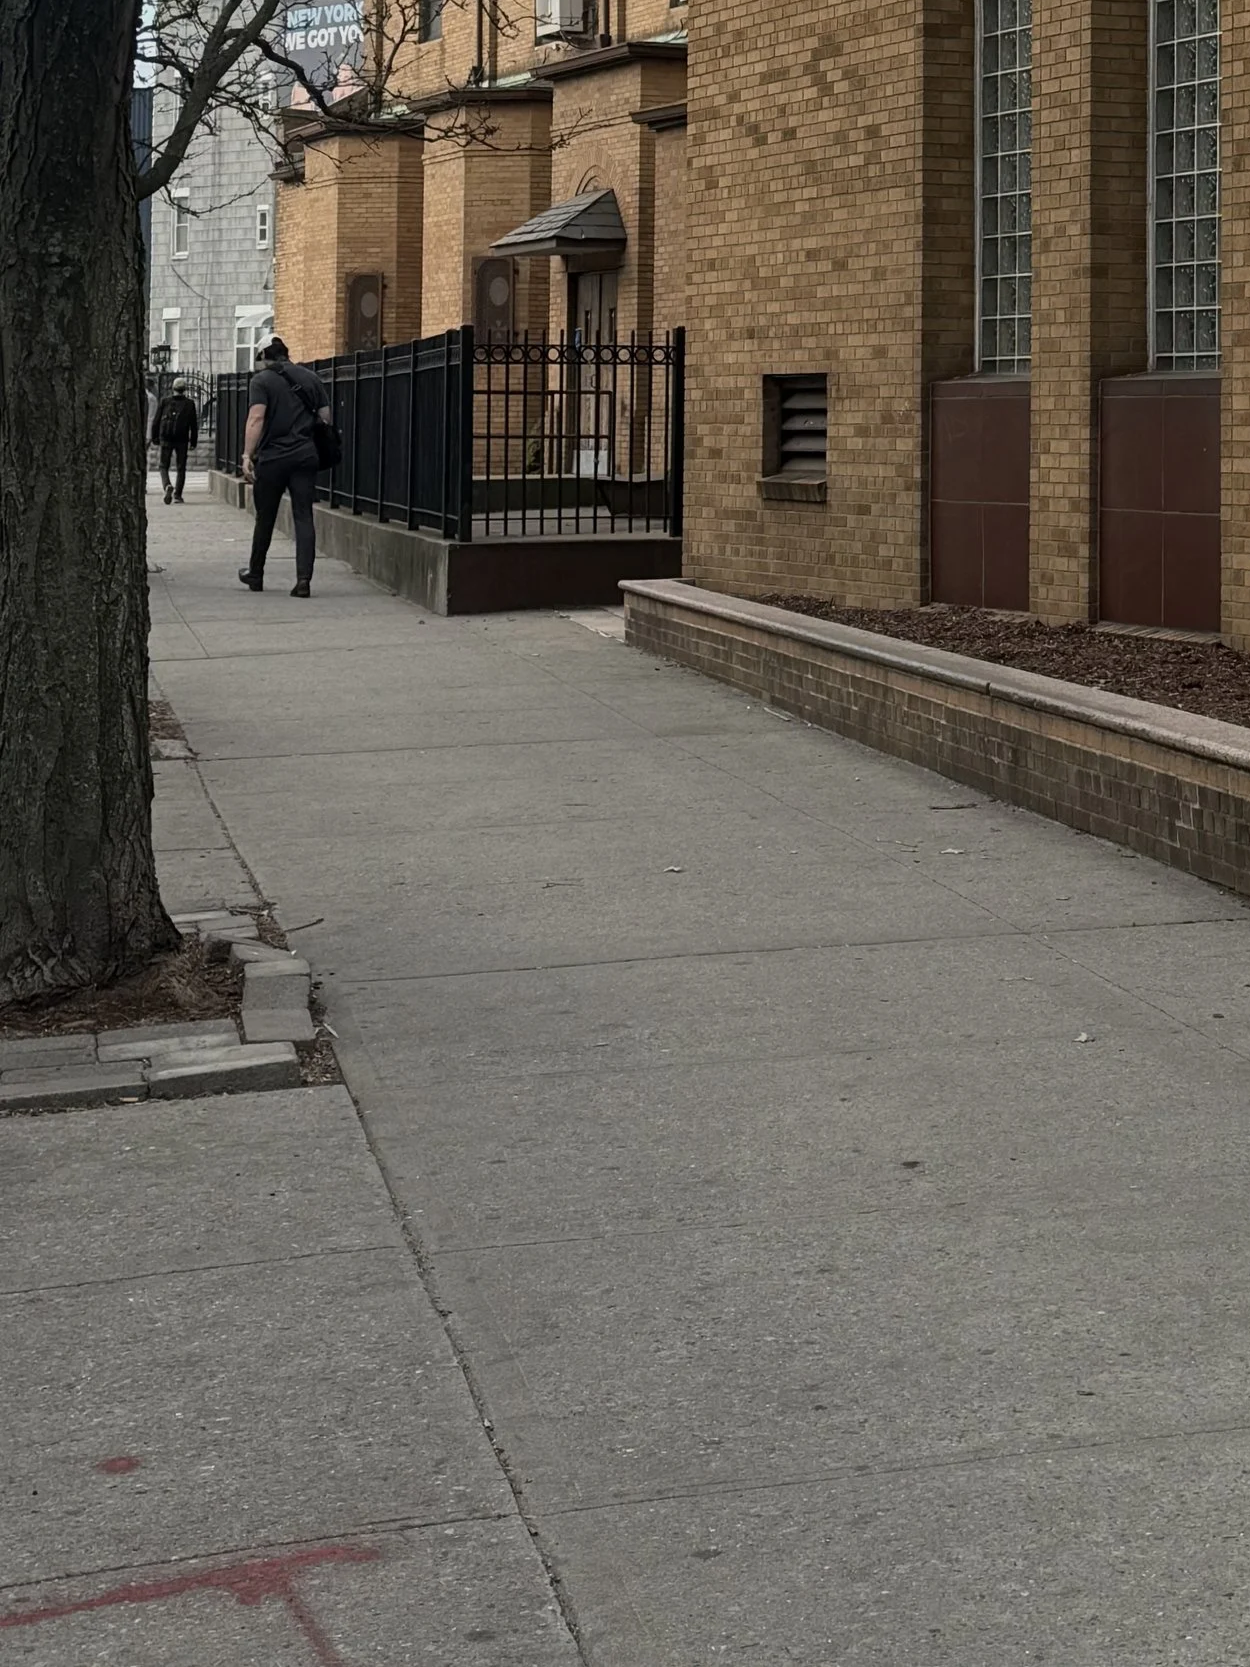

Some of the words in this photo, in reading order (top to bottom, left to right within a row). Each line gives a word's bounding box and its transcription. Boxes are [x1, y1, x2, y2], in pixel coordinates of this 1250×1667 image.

[287, 7, 323, 28] NEW
[281, 31, 306, 51] WE
[307, 27, 338, 48] GOT
